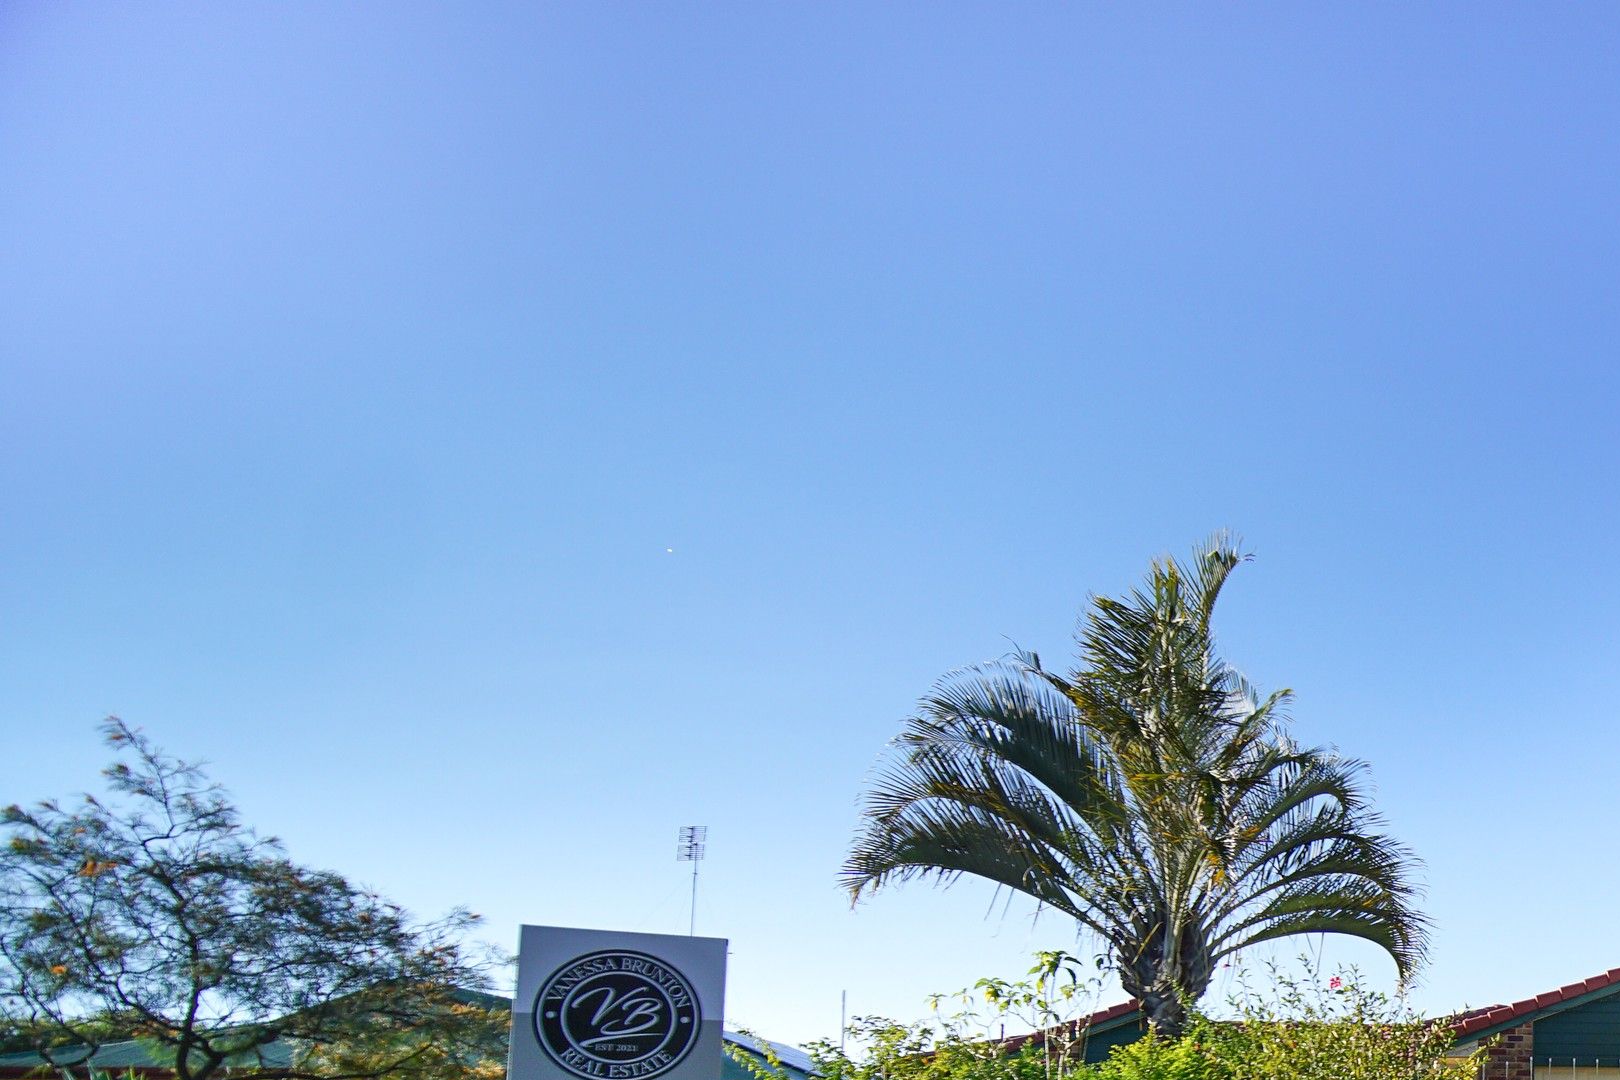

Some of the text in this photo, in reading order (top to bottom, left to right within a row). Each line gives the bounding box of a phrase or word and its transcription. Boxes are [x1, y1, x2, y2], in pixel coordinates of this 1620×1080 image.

[547, 957, 691, 1008] VANESSA BRUNTON
[561, 1048, 673, 1078] REAL ESTATE
